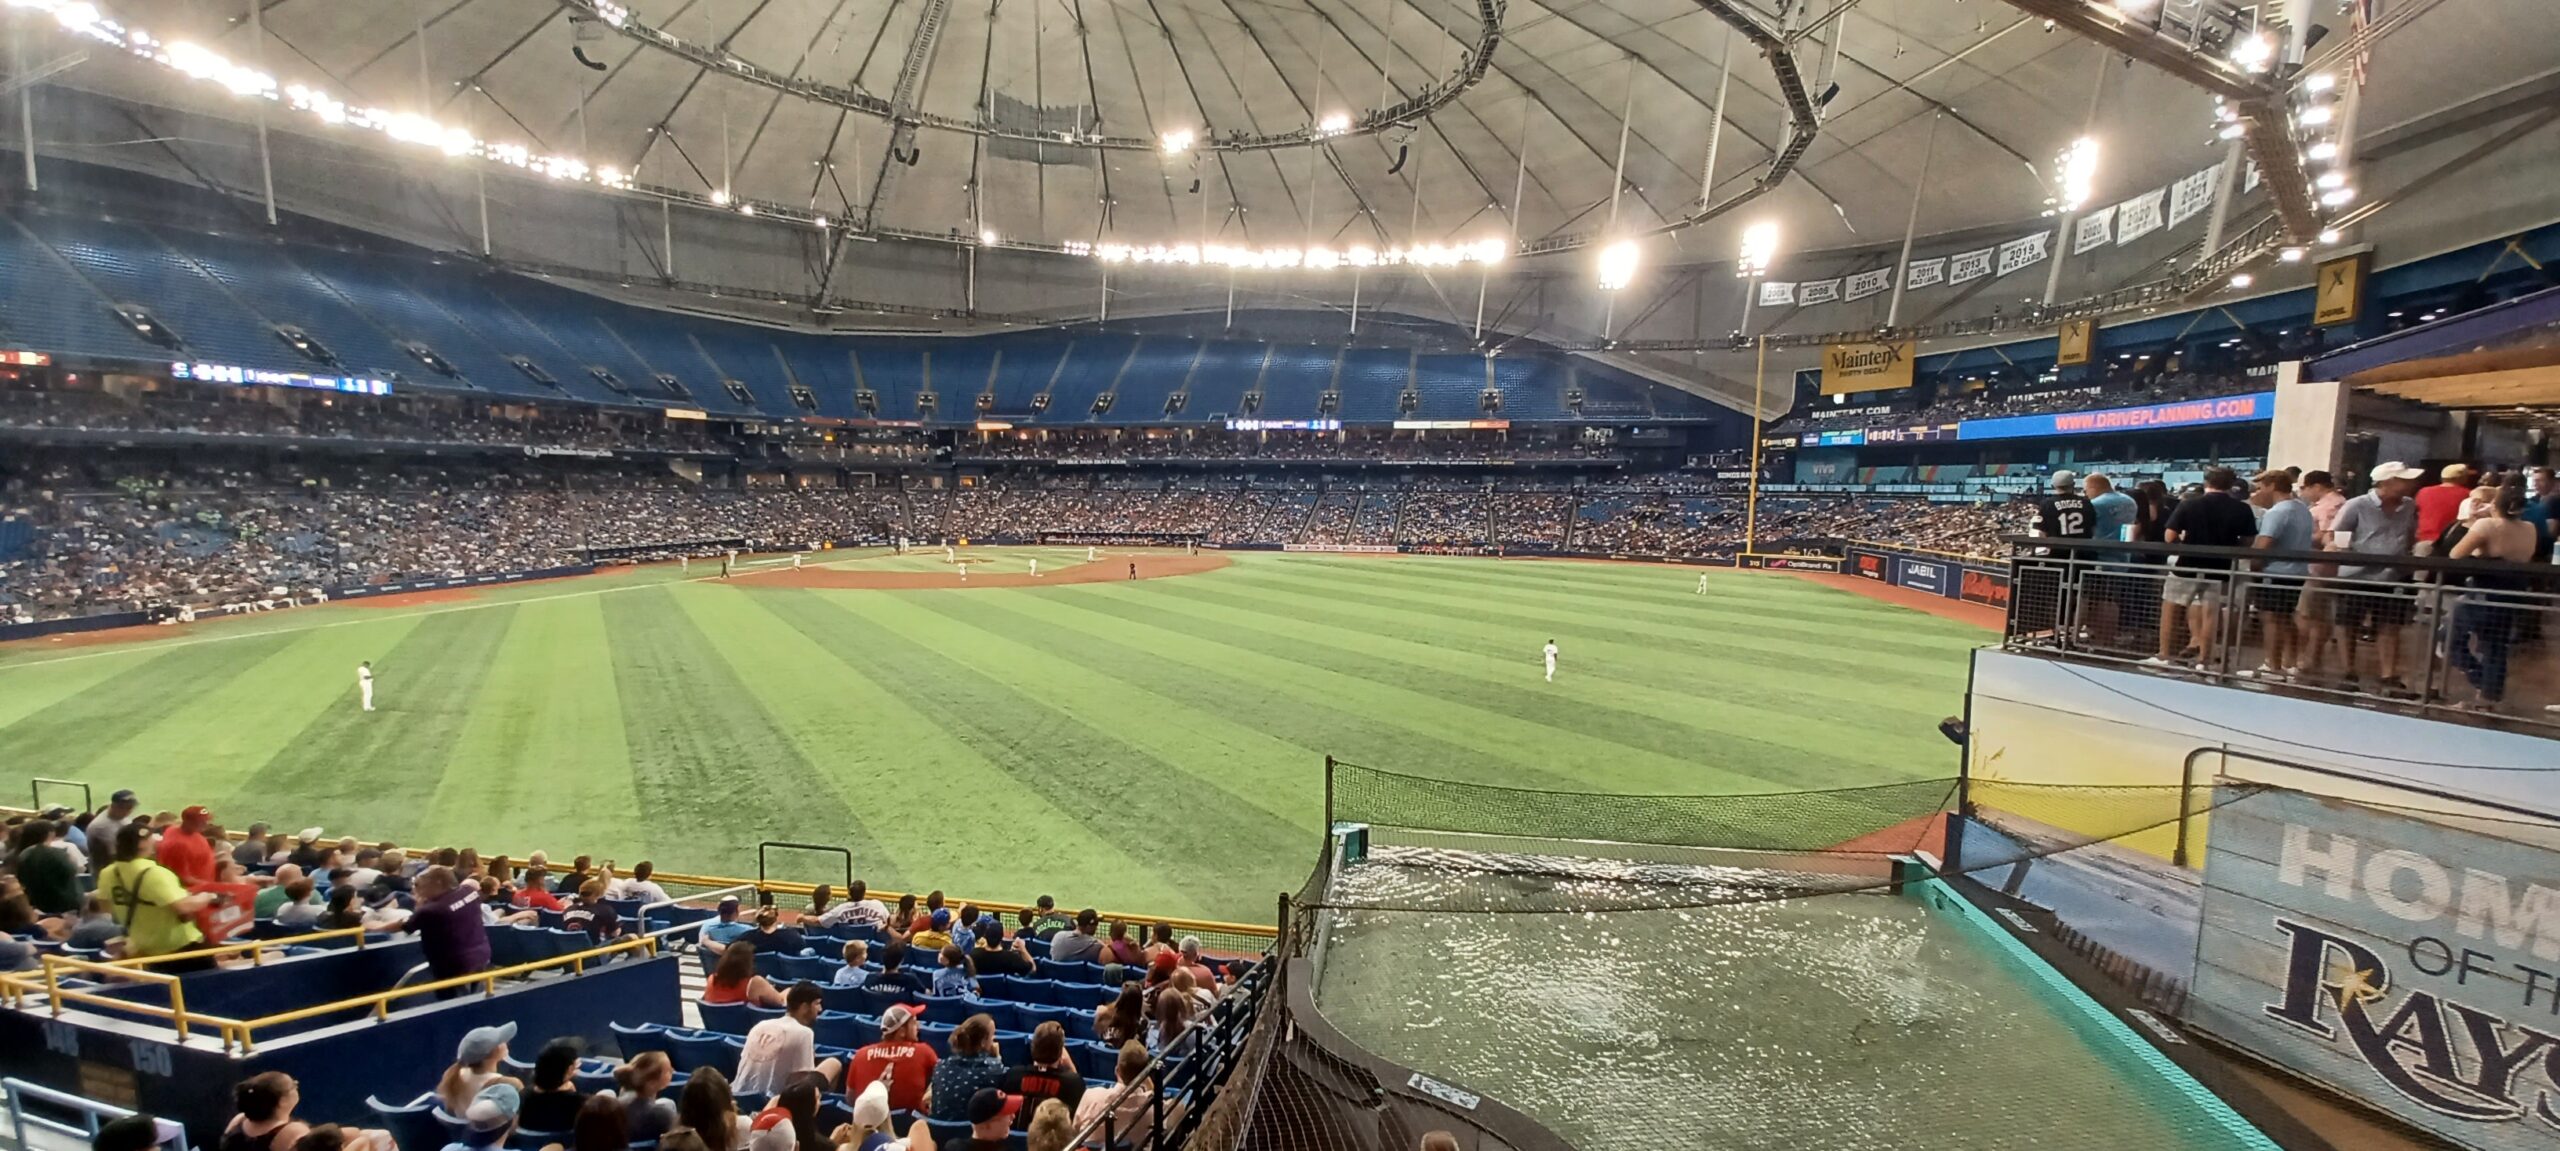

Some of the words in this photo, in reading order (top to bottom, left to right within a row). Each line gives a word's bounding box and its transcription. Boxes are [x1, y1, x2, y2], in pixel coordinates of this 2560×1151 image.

[2002, 259, 2019, 271] WILD
[2021, 251, 2042, 265] CARD
[2009, 243, 2036, 261] 2019
[1916, 266, 1935, 278] 2011
[1959, 257, 1981, 272] 2013
[1854, 277, 1878, 291] 2010
[1831, 342, 1905, 372] MaintenX
[2055, 398, 2256, 431] WWW.DRIVEPLANNING.COM
[2054, 499, 2083, 511] BOGGS
[2057, 512, 2084, 536] 12
[1907, 563, 1937, 579] JABIL
[2407, 936, 2495, 986] OF
[127, 1040, 173, 1078] 150
[866, 1045, 916, 1062] PHILLIPS
